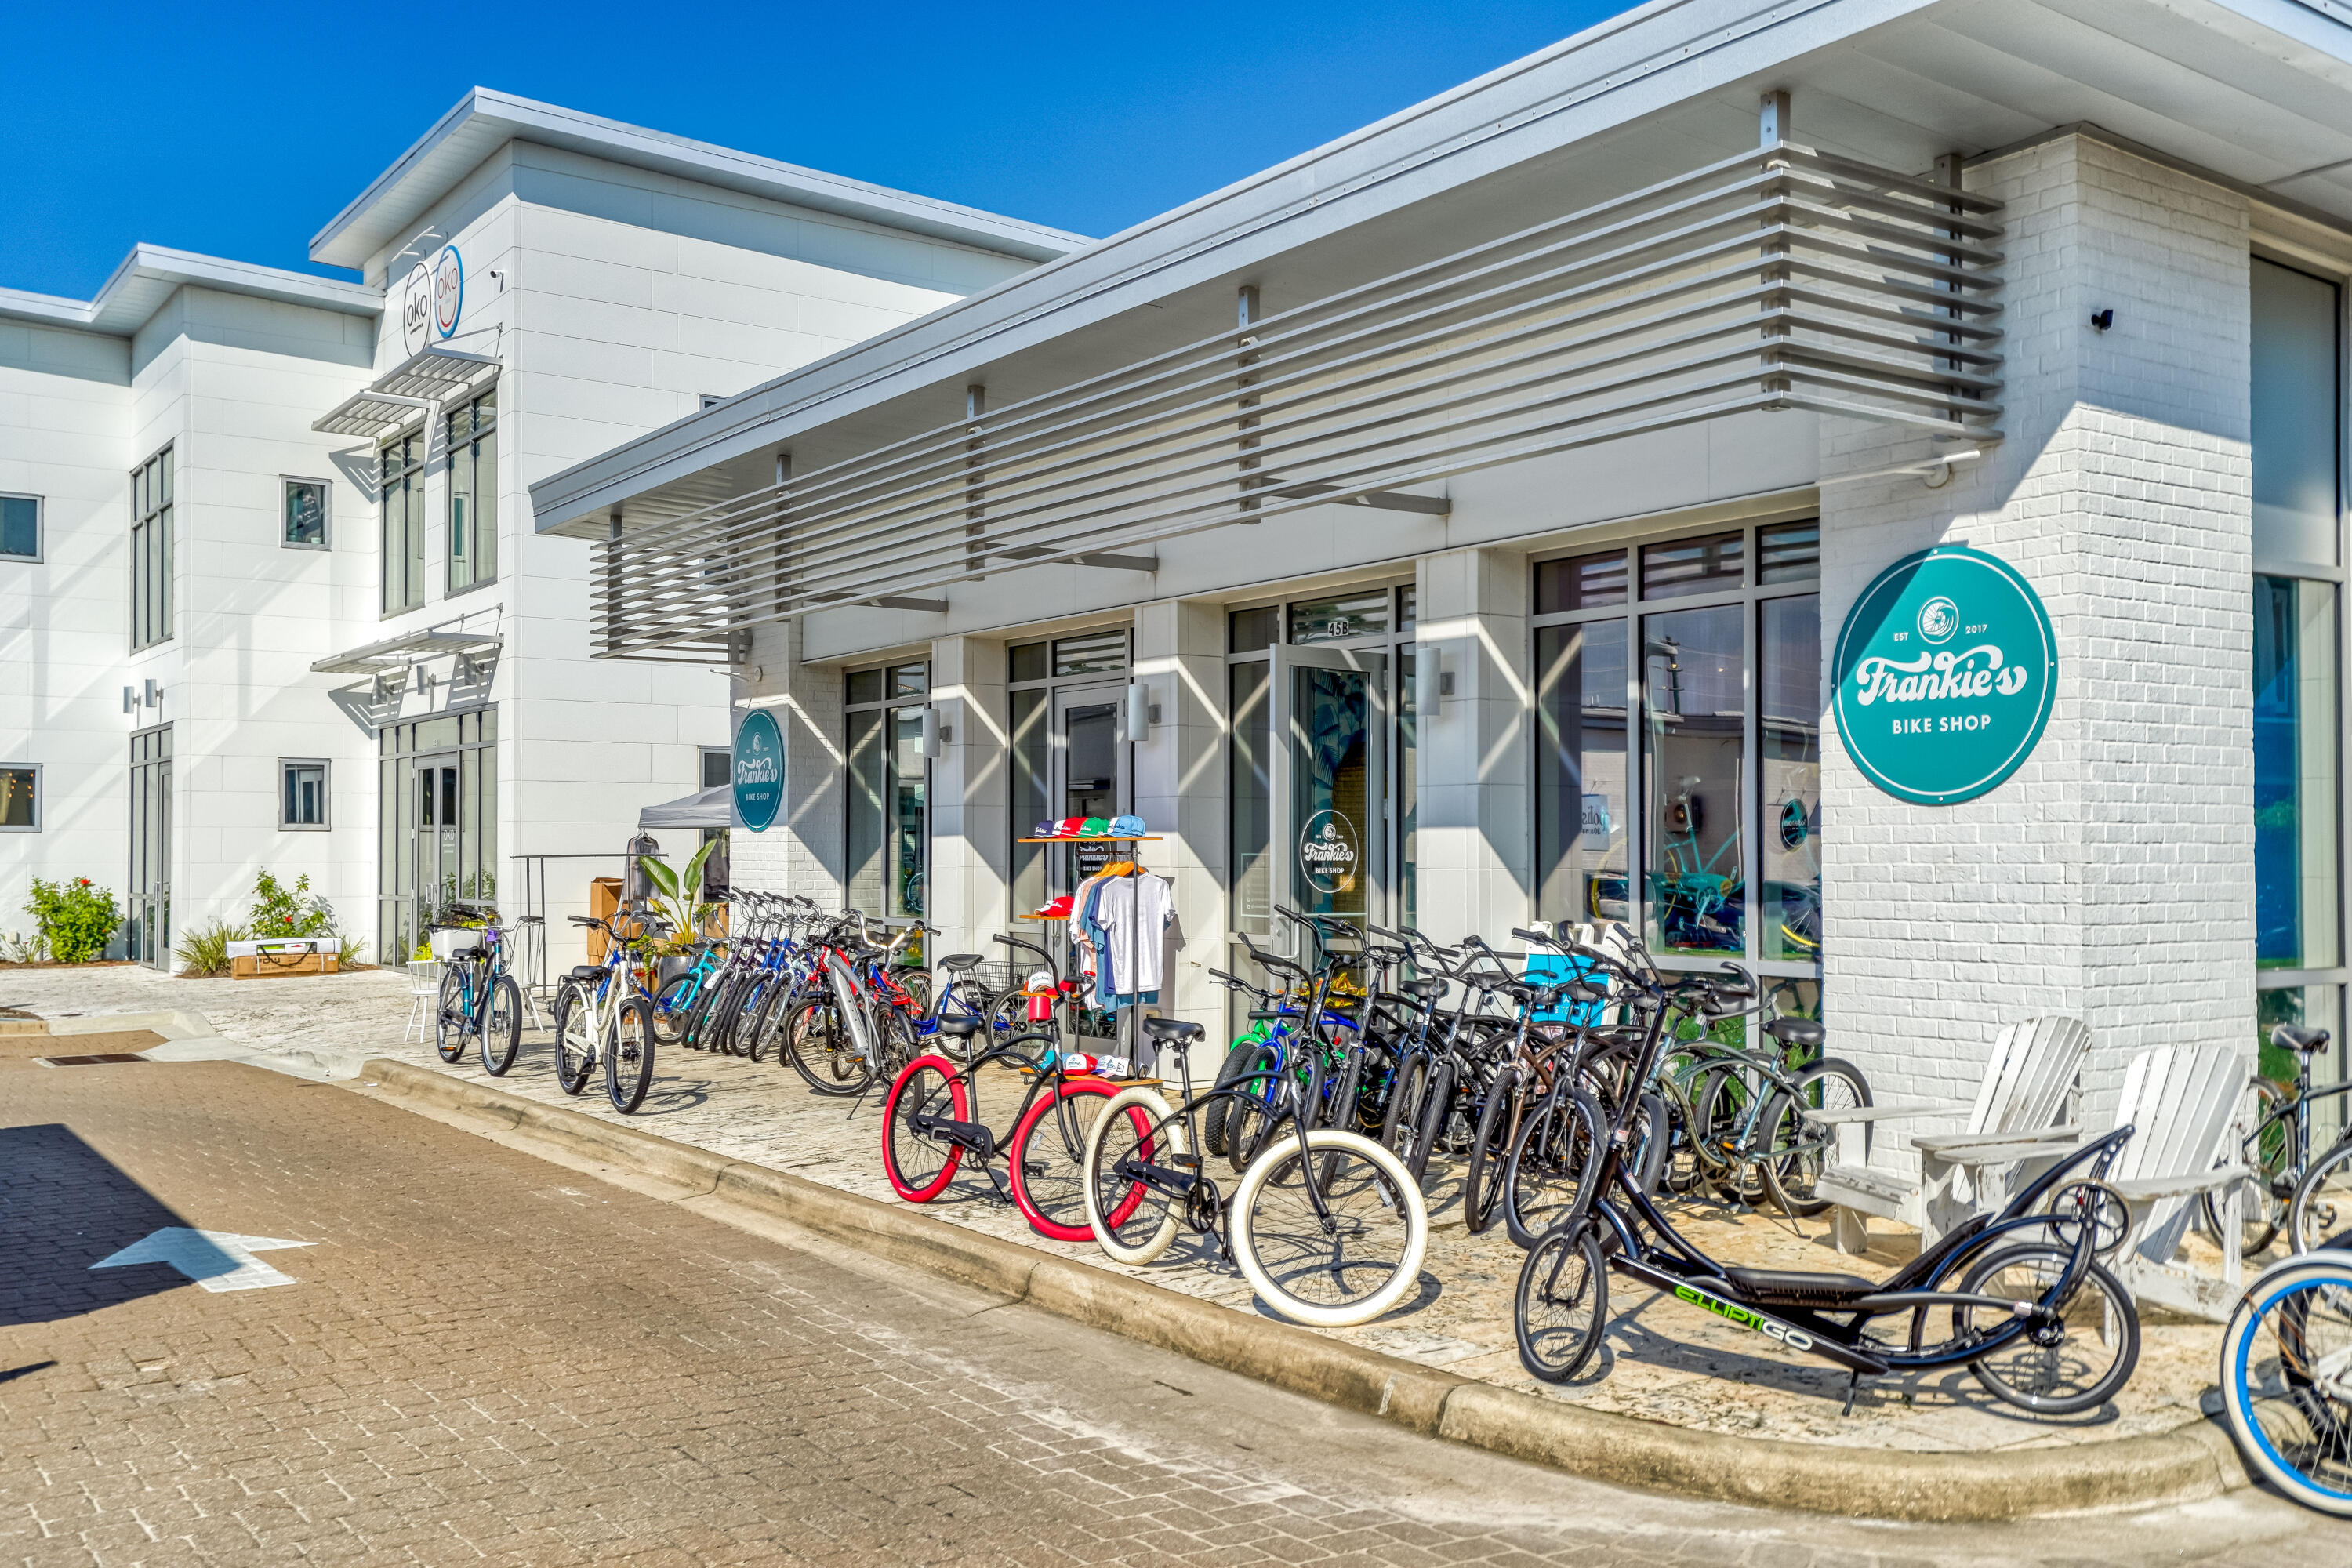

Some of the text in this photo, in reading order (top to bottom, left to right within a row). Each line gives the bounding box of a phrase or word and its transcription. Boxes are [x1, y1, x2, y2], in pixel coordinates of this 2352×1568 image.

[437, 267, 458, 299] oko
[406, 292, 427, 327] oko
[1329, 622, 1348, 637] 45B
[1893, 623, 1988, 642] EST 2017
[1856, 644, 2027, 706] Frankie's
[1893, 714, 1991, 735] BIKE SHOP
[757, 792, 770, 800] SHOP
[1675, 1284, 1813, 1352] ELLIPTIGO
